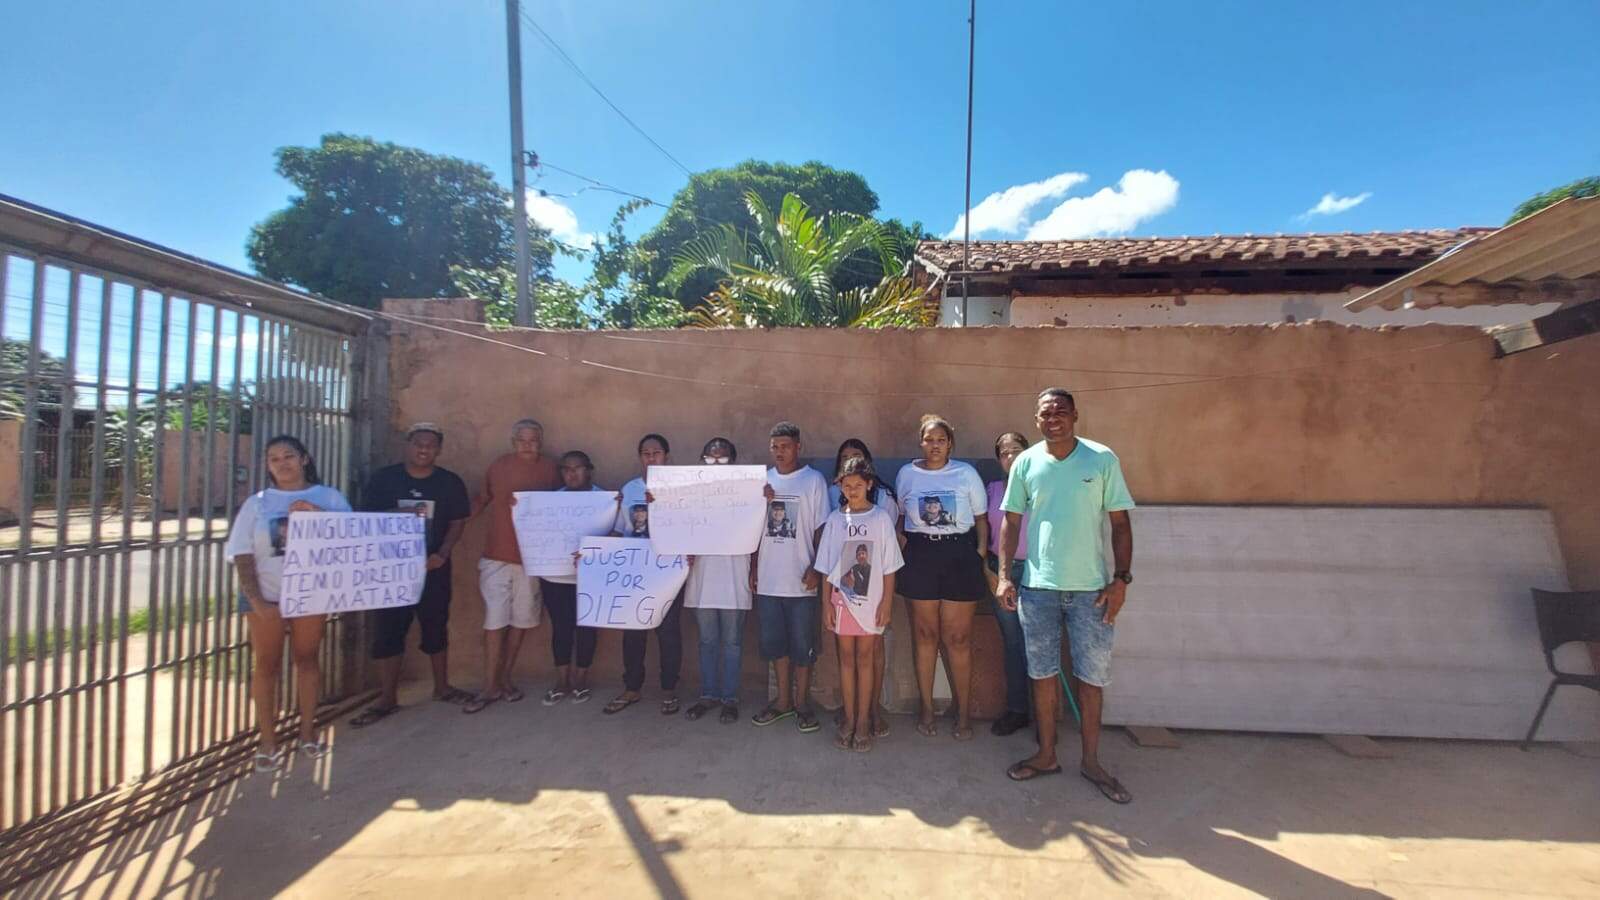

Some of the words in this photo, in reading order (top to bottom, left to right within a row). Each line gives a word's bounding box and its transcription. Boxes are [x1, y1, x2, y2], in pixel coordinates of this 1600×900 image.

[291, 518, 373, 540] NINGUEM
[848, 524, 868, 537] DG
[284, 549, 302, 569] A
[282, 572, 328, 594] TEM
[353, 561, 418, 587] DIREITO
[605, 570, 646, 590] POR
[285, 596, 311, 616] DE
